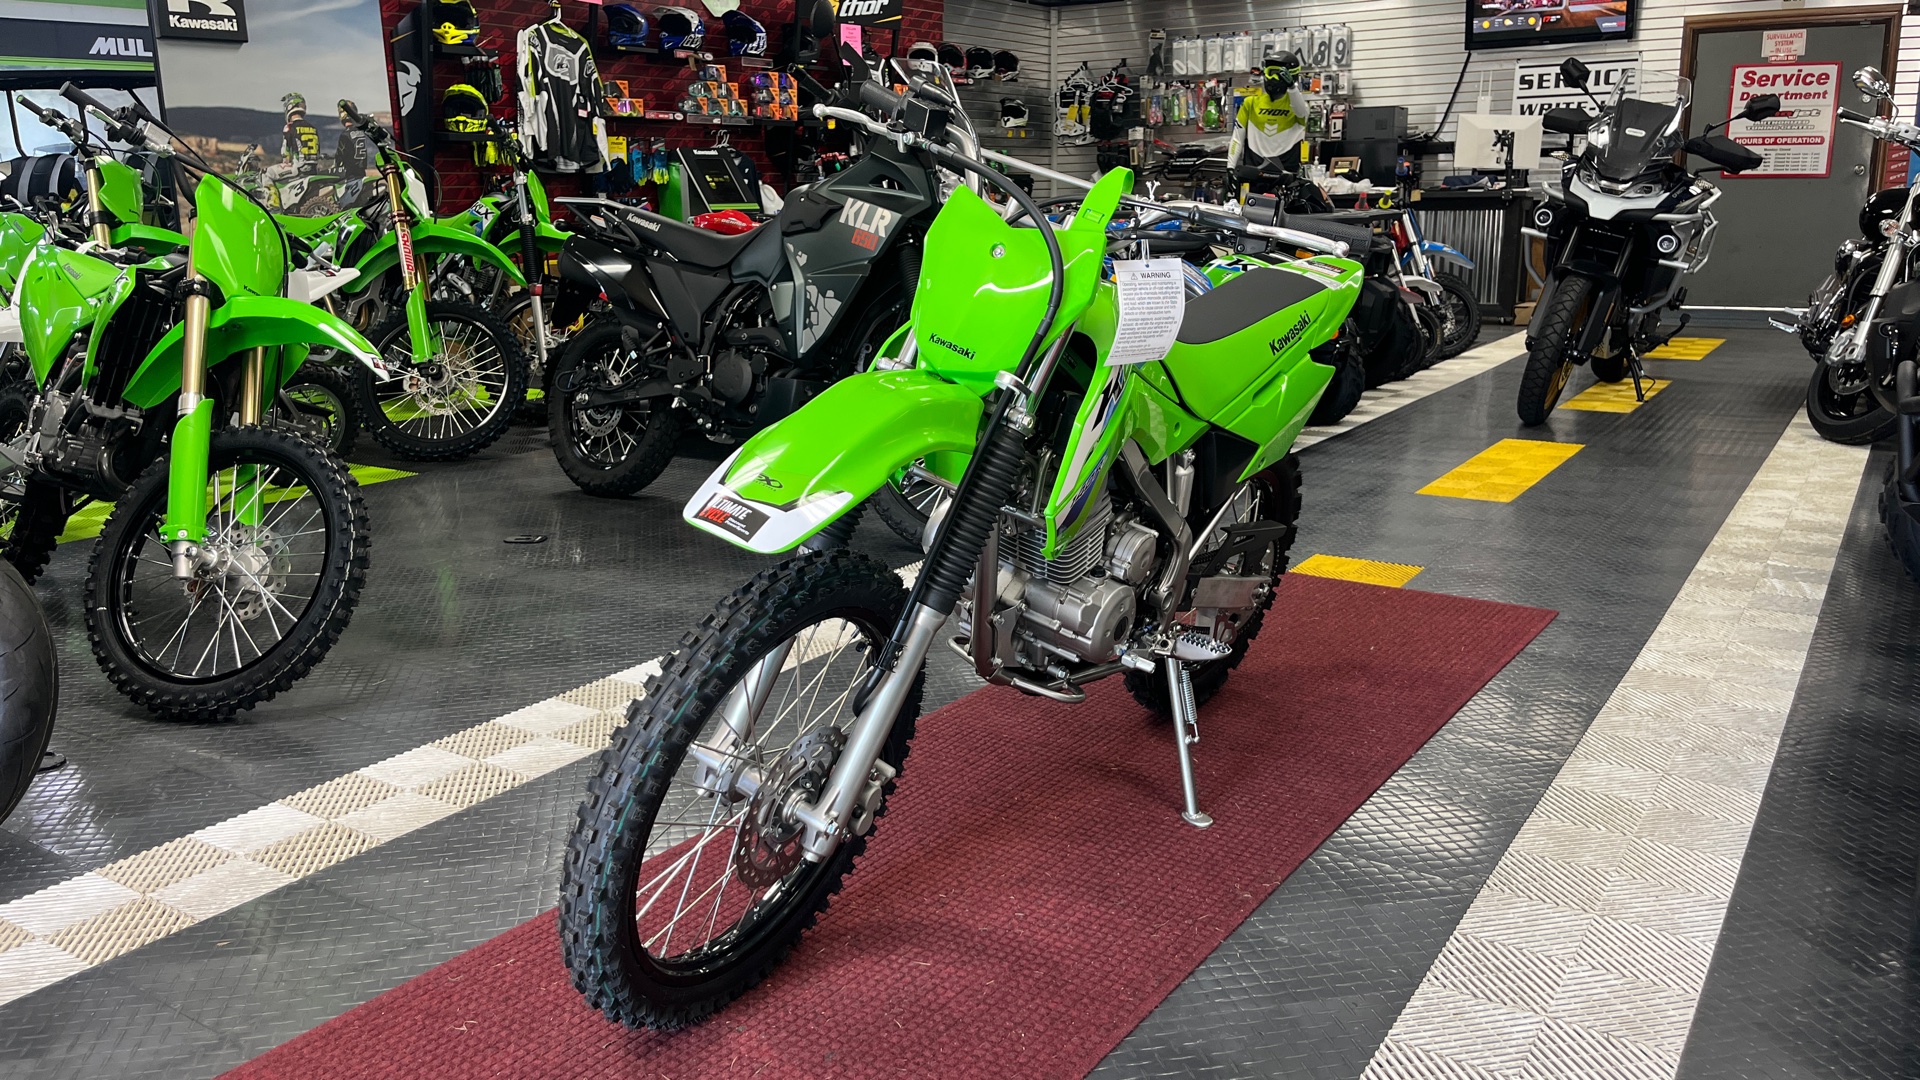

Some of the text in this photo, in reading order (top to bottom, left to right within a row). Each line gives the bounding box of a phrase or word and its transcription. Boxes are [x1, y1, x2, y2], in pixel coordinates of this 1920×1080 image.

[169, 15, 238, 31] Kawasaki
[1312, 41, 1328, 66] 8
[1334, 38, 1346, 64] 9
[1741, 69, 1830, 88] Service
[1258, 108, 1290, 116] THOR
[301, 134, 318, 155] 3
[626, 212, 662, 232] Kawasaki
[839, 198, 892, 238] KLR
[851, 228, 879, 251] 650
[1269, 310, 1311, 356] Kawasaki
[929, 333, 976, 360] Kawasaki
[698, 506, 732, 524] CYCLE
